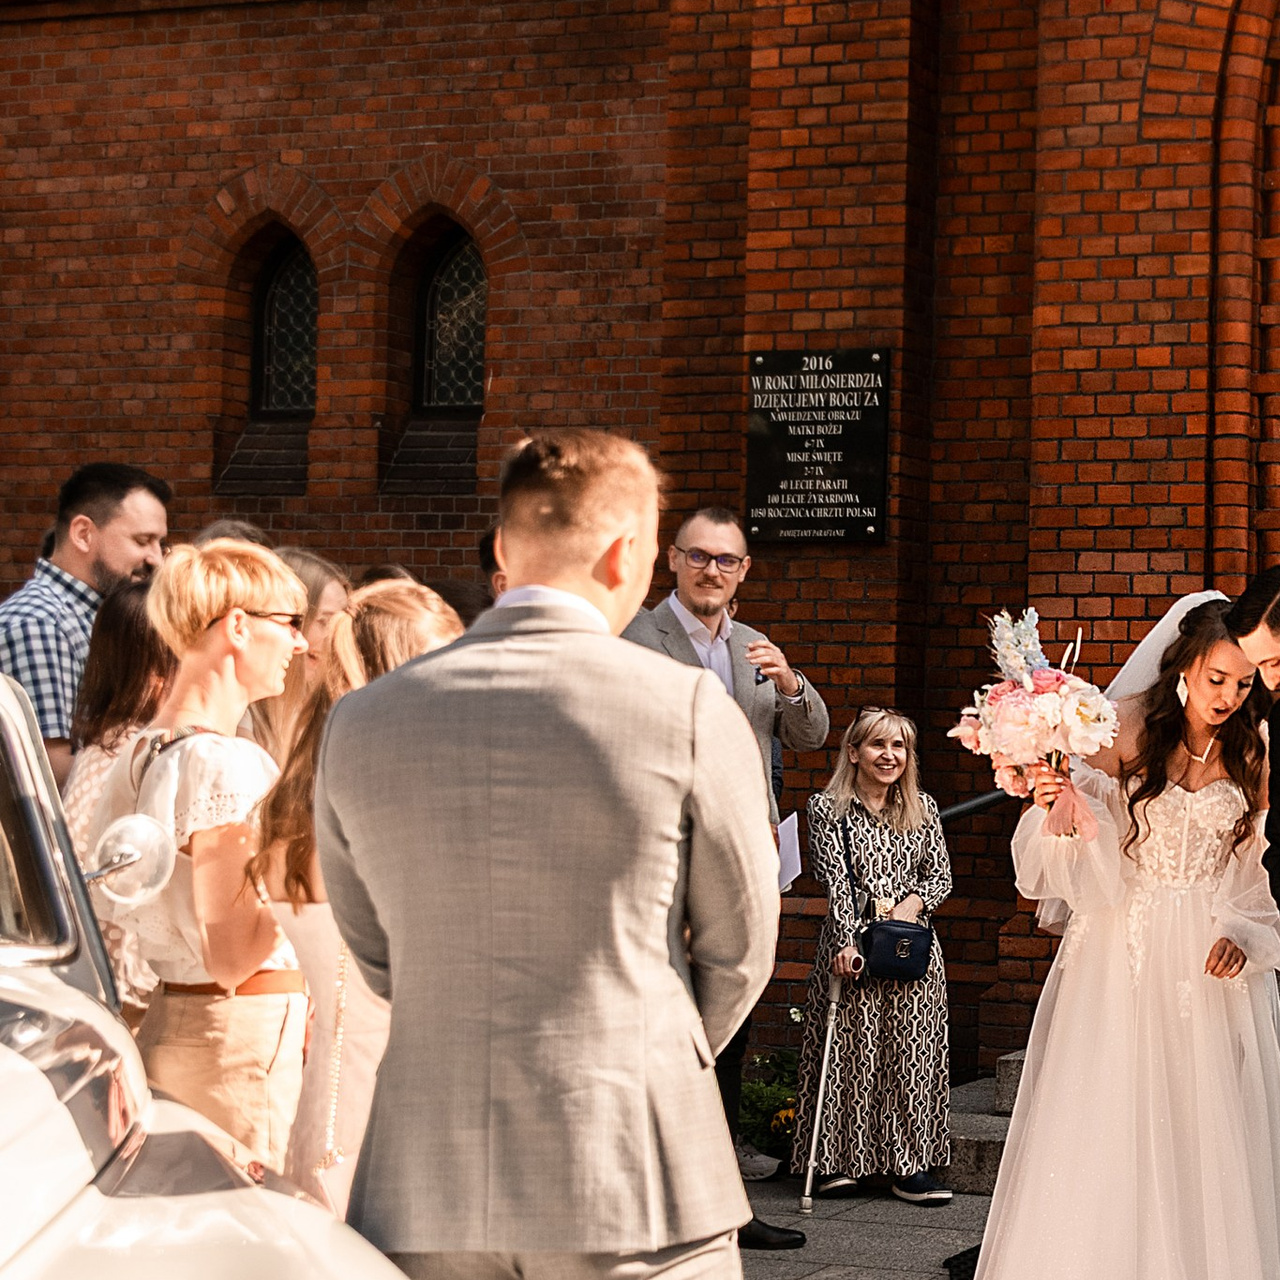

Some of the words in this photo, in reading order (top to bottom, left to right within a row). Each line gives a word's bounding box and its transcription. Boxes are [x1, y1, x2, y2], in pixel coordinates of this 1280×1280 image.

[801, 355, 833, 371] 2016
[751, 376, 763, 390] W
[764, 375, 798, 390] ROKU
[799, 373, 883, 389] MIŁOSIERDZIA
[753, 393, 828, 411] DZIĘKUJEMY
[829, 392, 862, 407] BOGU
[863, 392, 880, 407] ZA
[770, 410, 827, 422] NAWIEDZENIE
[827, 410, 862, 421] OBRAZU
[788, 425, 816, 435] MATKI
[816, 423, 843, 435] BOŻEJ
[816, 438, 825, 448] IX
[786, 452, 811, 462] MISJE
[811, 449, 843, 464] ŚWIĘTE
[815, 466, 824, 476] IX
[779, 480, 789, 490] 40
[790, 480, 815, 490] LECIE
[815, 479, 848, 490] PARAFII
[767, 494, 780, 504] 100
[781, 494, 806, 504] LECIE
[807, 491, 860, 504] ŻYRARDOWA
[751, 508, 767, 518] 1050
[767, 508, 810, 518] ROCZNICA
[810, 508, 845, 518] CHRZTU
[846, 507, 876, 518] POLSKI
